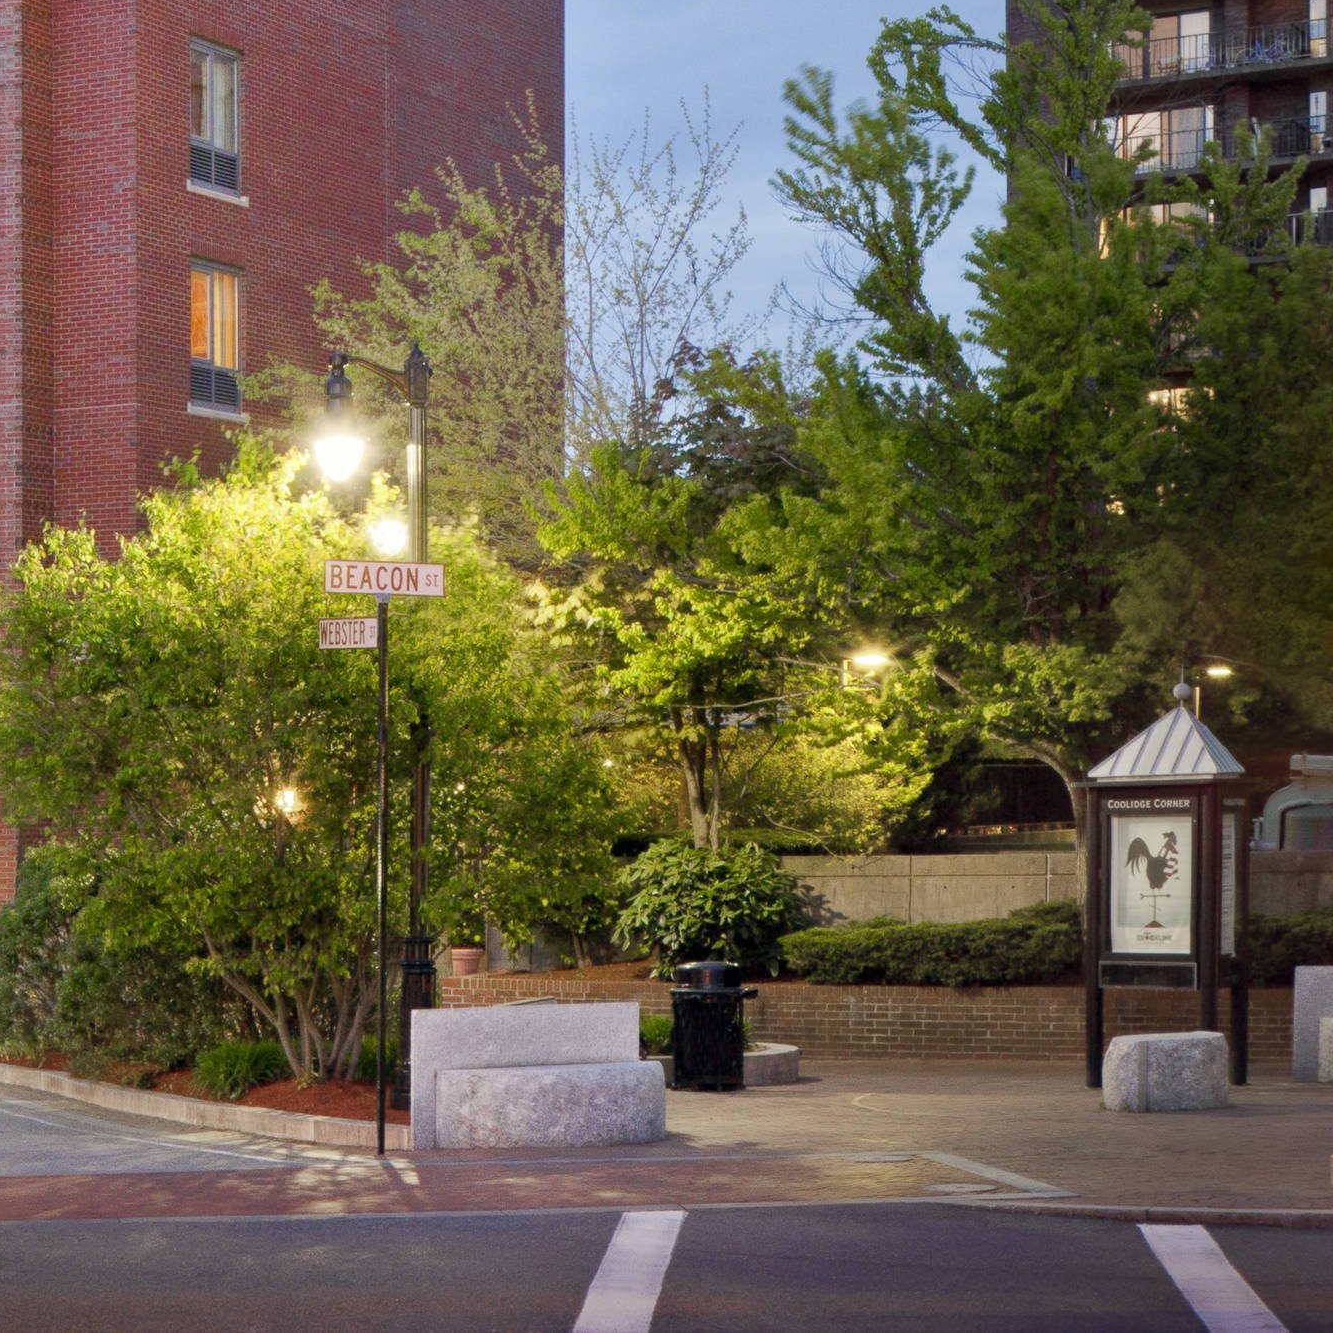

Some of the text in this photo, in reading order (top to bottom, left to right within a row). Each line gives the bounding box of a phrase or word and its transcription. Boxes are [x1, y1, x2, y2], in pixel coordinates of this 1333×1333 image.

[330, 564, 439, 592] BEACON ST
[321, 621, 366, 645] WEBSTER
[1108, 798, 1190, 809] COOLIDGE CORNER
